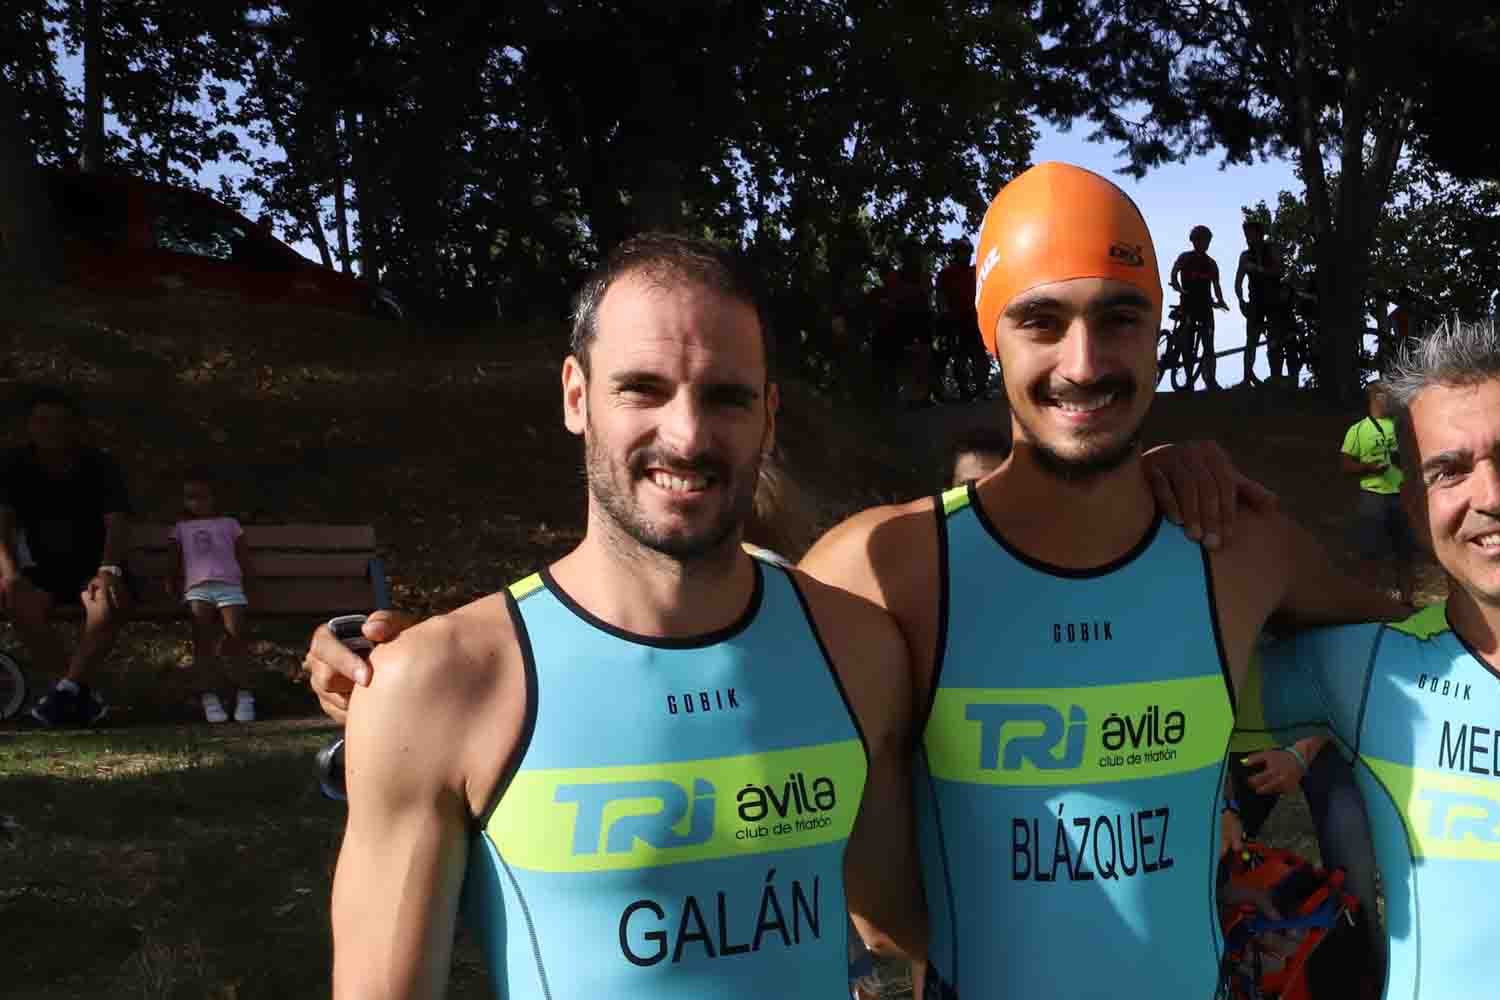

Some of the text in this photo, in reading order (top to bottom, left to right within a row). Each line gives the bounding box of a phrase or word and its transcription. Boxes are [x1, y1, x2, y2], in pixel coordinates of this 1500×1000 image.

[1053, 622, 1113, 643] GOBIK
[1418, 673, 1472, 700] GOBIK
[667, 688, 740, 714] GOBIK
[772, 822, 792, 835] de
[1011, 803, 1174, 882] BLÁZQUEZ
[619, 869, 821, 967] GALÁN
